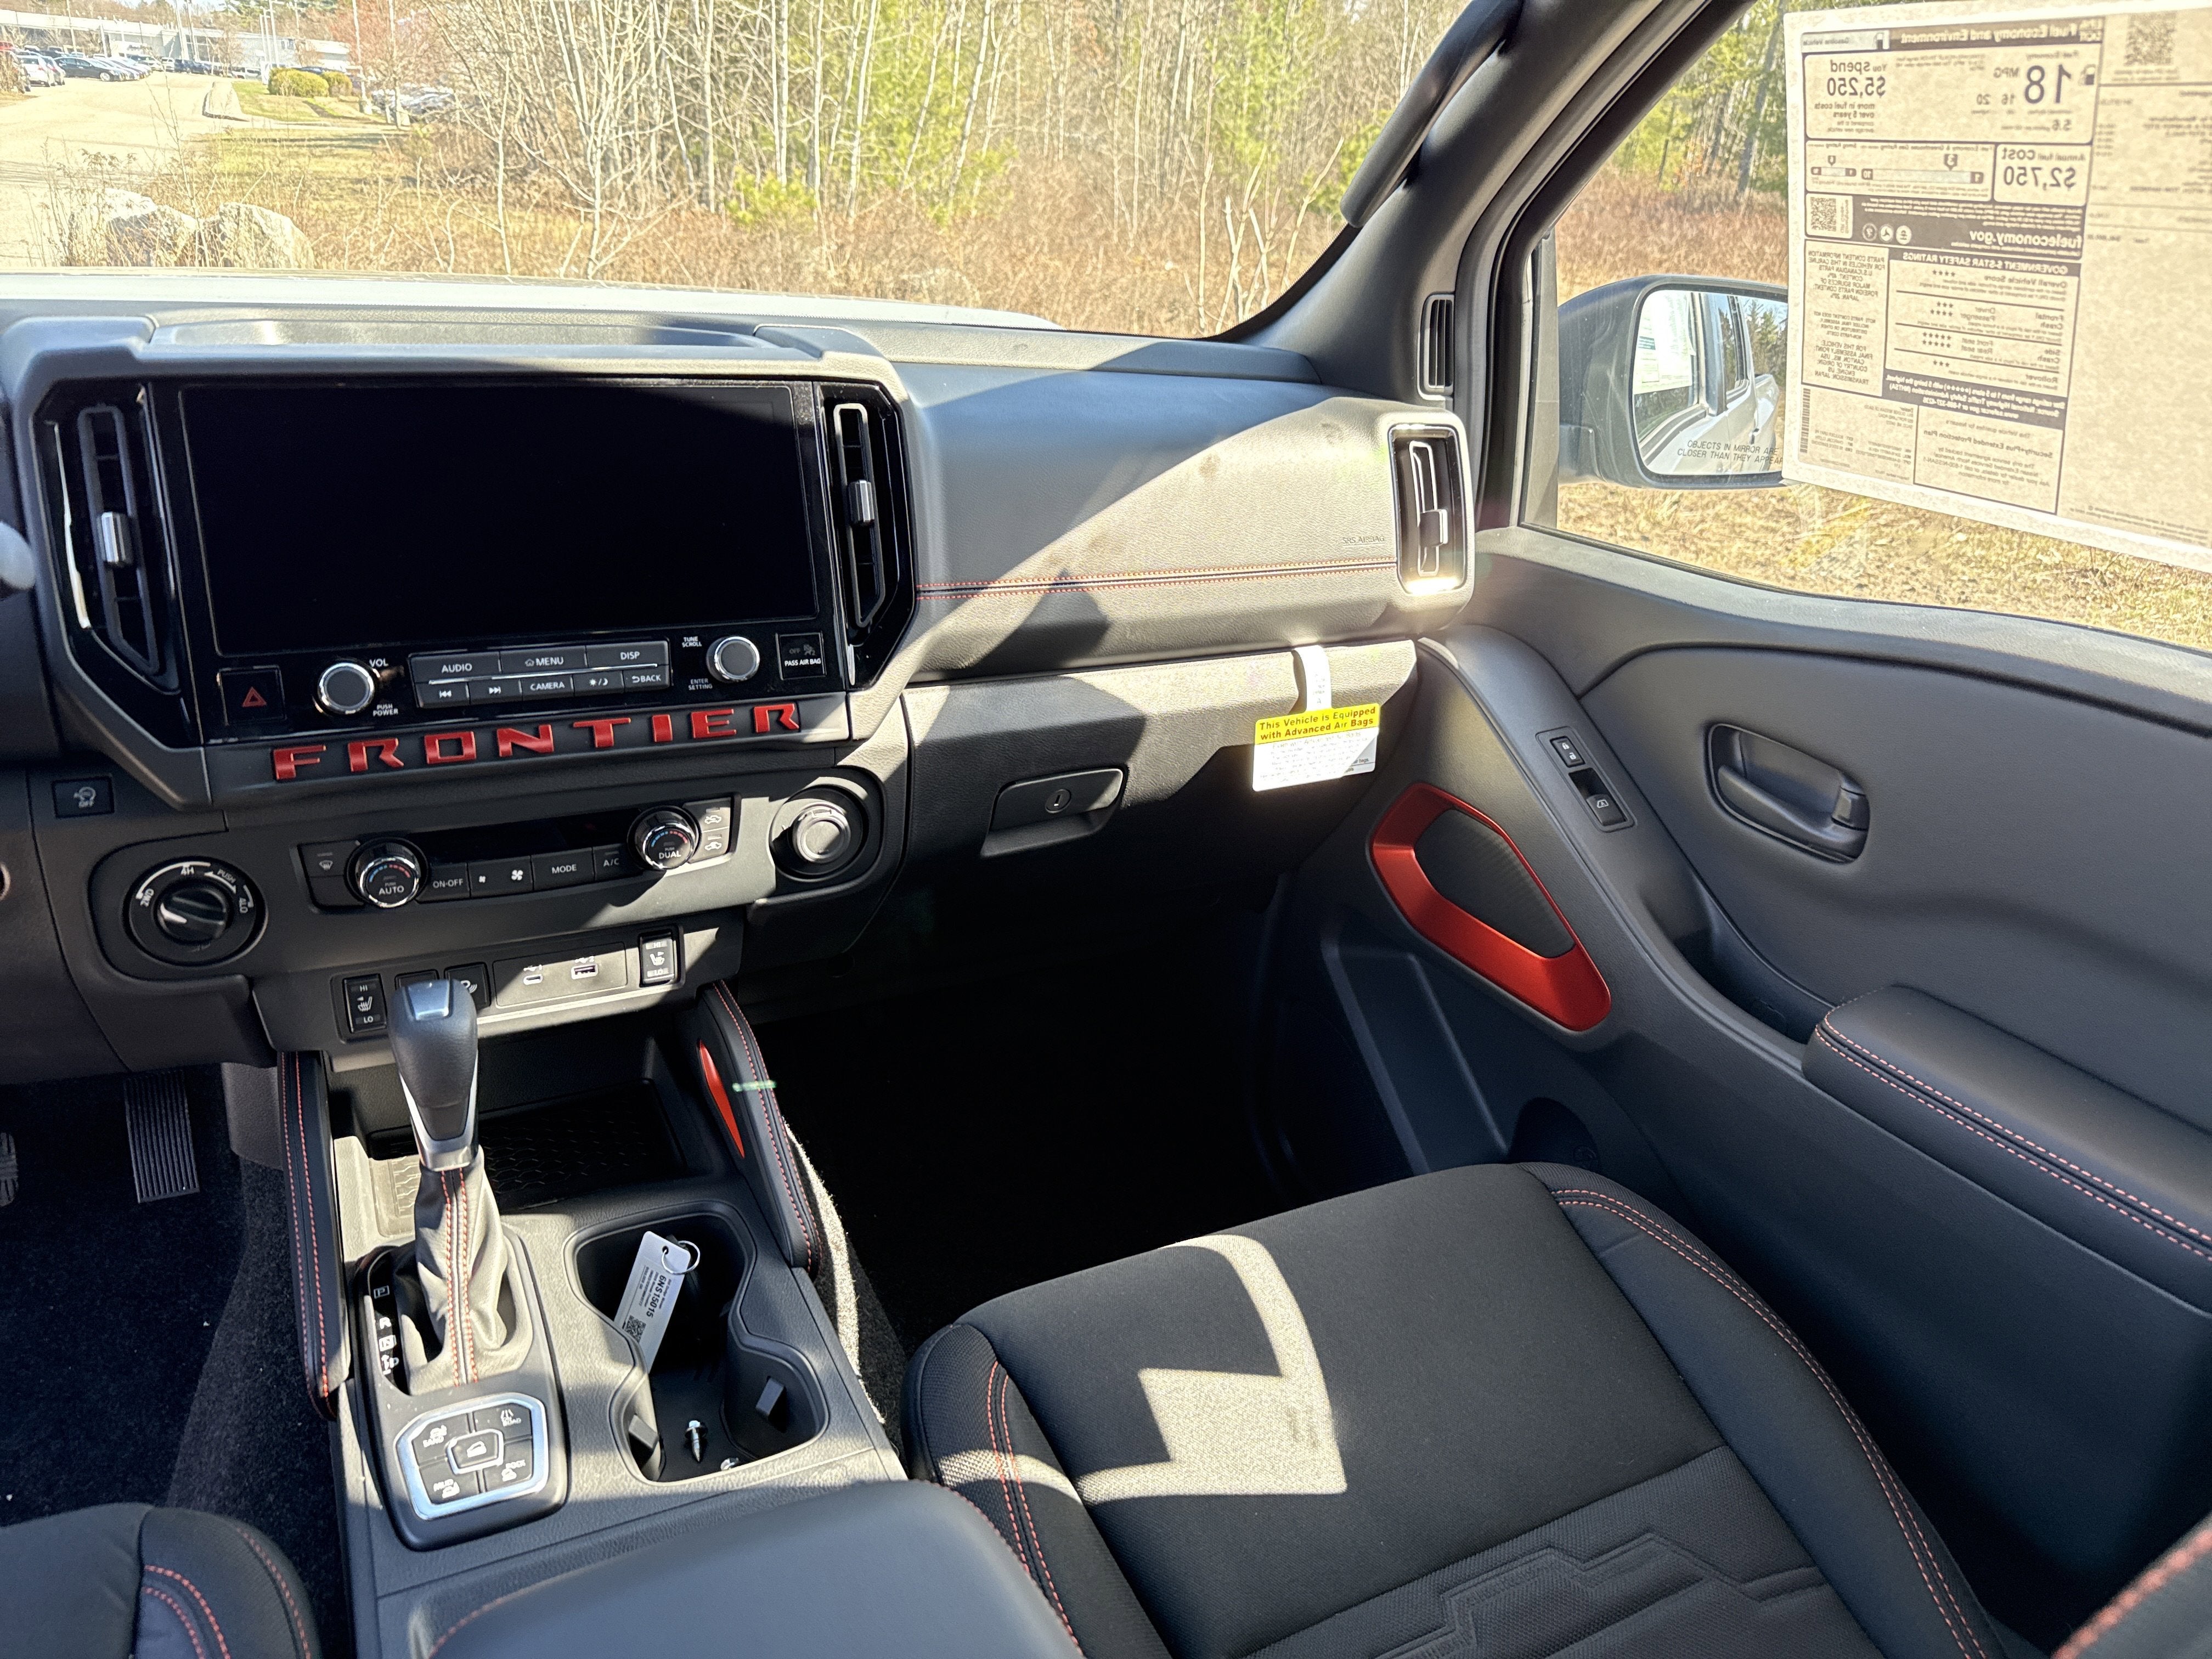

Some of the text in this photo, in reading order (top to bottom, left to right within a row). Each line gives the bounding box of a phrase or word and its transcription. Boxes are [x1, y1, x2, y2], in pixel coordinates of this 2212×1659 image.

[1688, 440, 1721, 450] OBJECTS
[1734, 444, 1760, 454] MIRROR
[1763, 447, 1779, 455] ARE
[1677, 448, 1783, 465] CLOSER THAN THEY APPEAR
[1342, 536, 1356, 544] SRS
[535, 656, 564, 666] MENU
[620, 651, 640, 661] DISP
[369, 658, 389, 668] VOL
[442, 662, 473, 673] AUDIO
[641, 674, 662, 683] BACK
[530, 680, 565, 691] CAMERA
[373, 708, 399, 716] POWER
[1260, 706, 1376, 731] This Vehicle is Equipped
[1260, 717, 1374, 741] with Advanced Air Bags
[273, 703, 799, 780] FRONTIER
[658, 850, 681, 859] DUAL
[603, 857, 619, 867] A/C
[180, 866, 195, 876] 4H
[551, 864, 577, 874] MODE
[217, 868, 236, 883] PUSH
[379, 885, 404, 895] AUTO
[140, 888, 154, 907] 2WD
[646, 1274, 667, 1318] 6NS15015
[379, 1317, 392, 1329] R
[422, 1435, 444, 1448] SAND
[505, 1459, 526, 1469] ROCK
[433, 1479, 454, 1492] MUD
